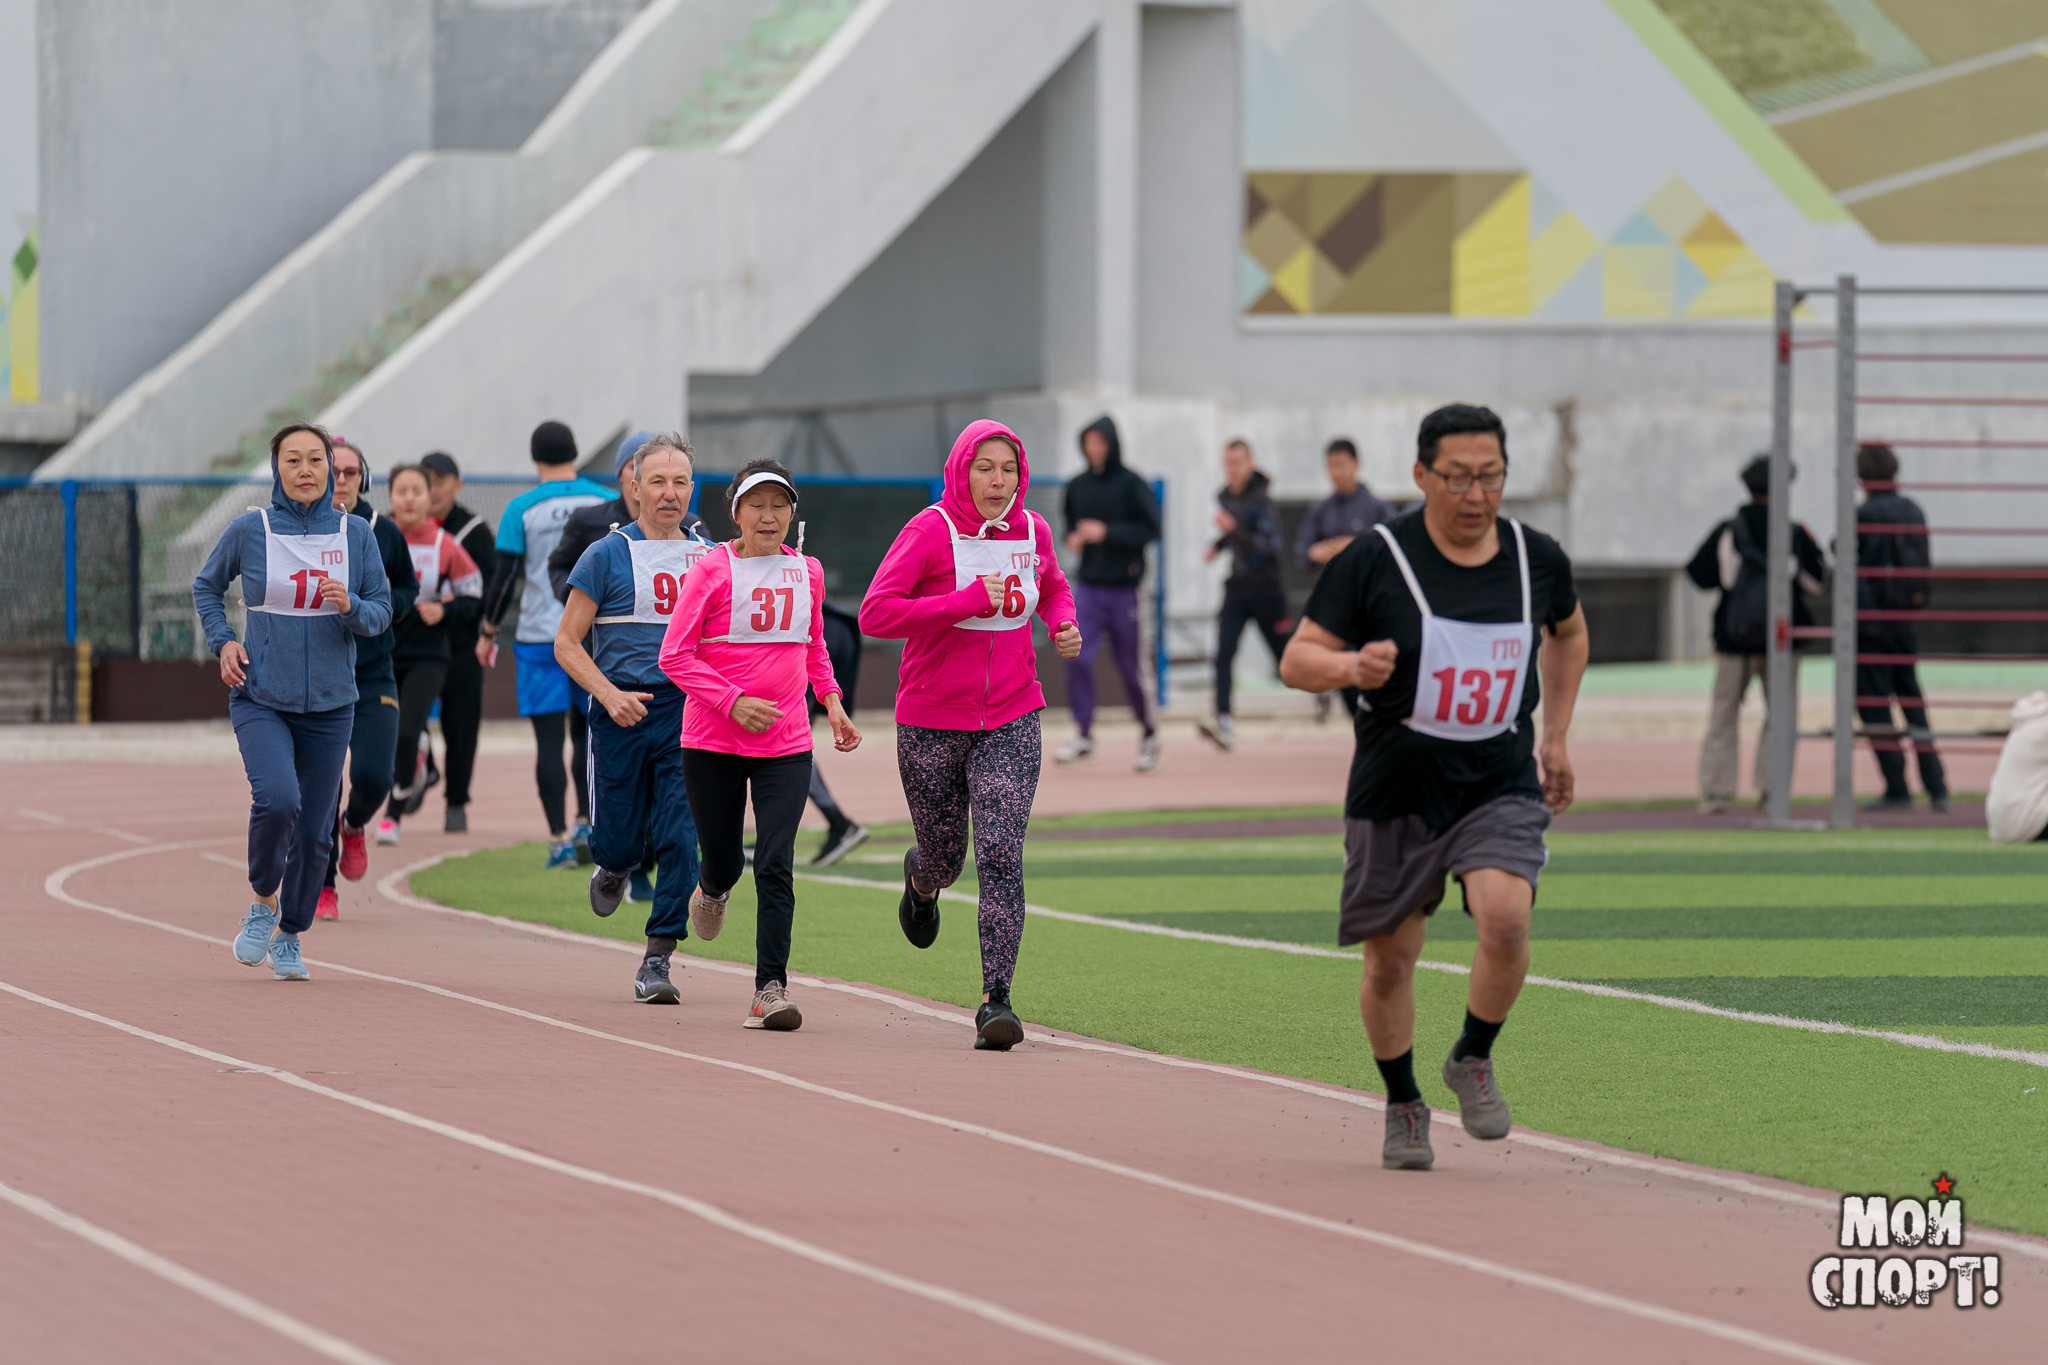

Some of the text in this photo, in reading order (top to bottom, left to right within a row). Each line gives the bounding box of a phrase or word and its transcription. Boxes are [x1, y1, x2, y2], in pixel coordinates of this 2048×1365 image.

[320, 550, 344, 566] ГТО
[1011, 552, 1031, 570] ГТО
[289, 568, 330, 610] 17
[782, 567, 803, 583] ГТО
[653, 572, 687, 615] 9
[750, 587, 793, 632] 37
[1491, 638, 1522, 660] ГТО
[1432, 666, 1517, 725] 137
